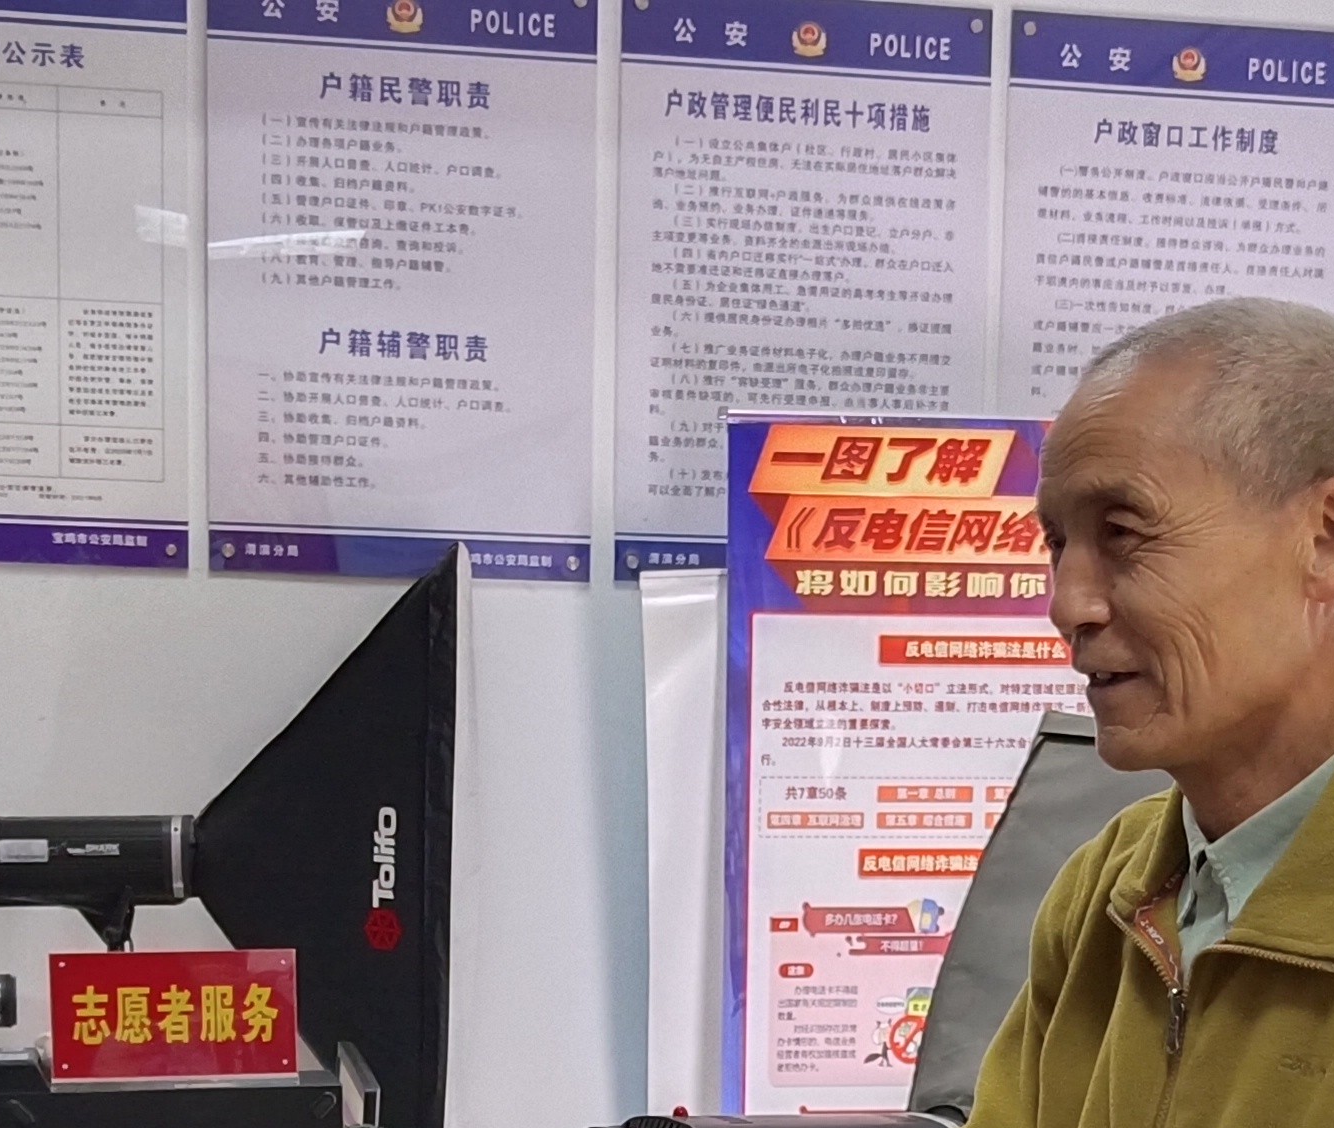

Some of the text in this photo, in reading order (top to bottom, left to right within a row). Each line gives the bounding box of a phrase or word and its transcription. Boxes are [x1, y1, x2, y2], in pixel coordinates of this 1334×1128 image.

[470, 9, 556, 38] POLICE
[674, 18, 749, 48] 公安
[869, 32, 952, 61] POLICE
[1060, 43, 1131, 72] 公安
[1248, 58, 1327, 85] POLICE
[319, 71, 491, 109] 户籍民警职责
[665, 88, 931, 133] 户政管理便民利民十项措施
[1094, 118, 1279, 155] 户政窗口工作制度
[318, 327, 488, 362] 户籍辅警职责
[770, 436, 992, 484] 一图了解
[786, 507, 1048, 554] 《反电信网络
[470, 552, 552, 569] 鸡市公安局监制
[795, 570, 1047, 599] 将如何影响你
[905, 641, 1066, 660] 反电信网络诈骗法是什么
[785, 786, 847, 800] 共7章50条
[372, 806, 397, 908] Tolifo
[71, 983, 280, 1046] 志愿者服务
